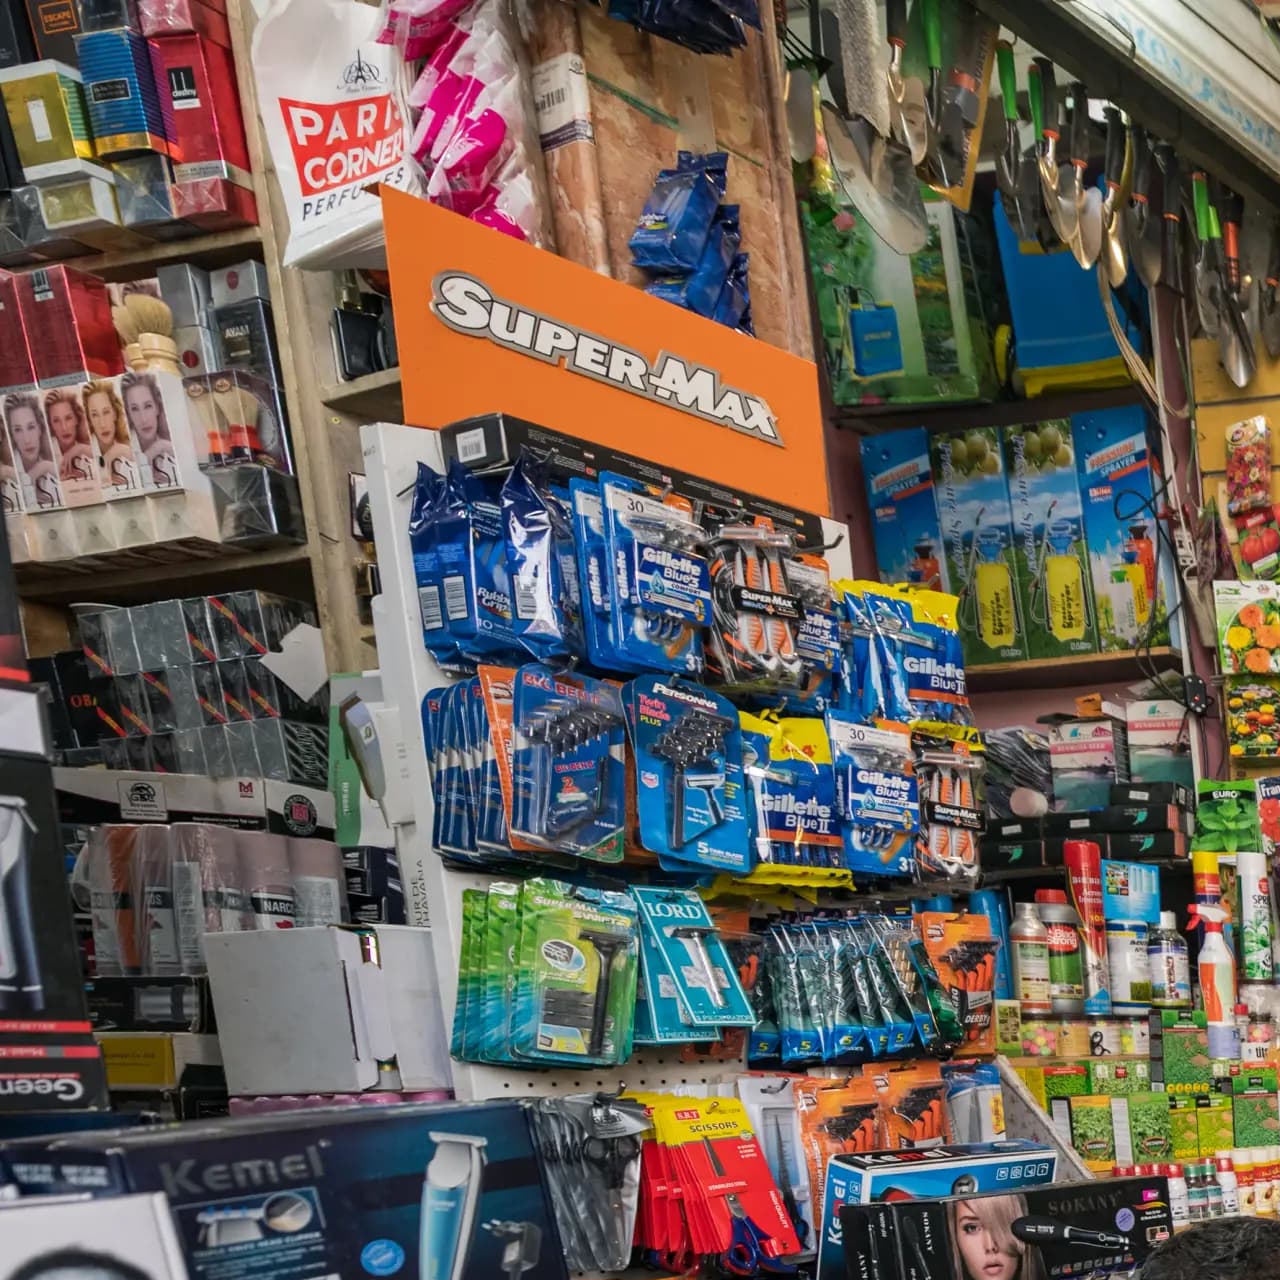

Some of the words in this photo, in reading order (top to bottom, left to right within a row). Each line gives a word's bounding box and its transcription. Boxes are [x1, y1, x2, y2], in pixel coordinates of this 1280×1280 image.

[289, 99, 403, 147] PARI
[304, 135, 402, 190] CORNER
[301, 166, 404, 222] PERFUES
[433, 273, 778, 441] SUPER-MAX
[1100, 455, 1137, 478] SPRAYER
[884, 476, 921, 496] SPRAYER
[627, 499, 644, 513] 30
[642, 547, 702, 576] Gillette
[588, 556, 602, 605] Gillette
[615, 549, 630, 599] Gillette
[903, 657, 965, 678] Gillette
[652, 682, 718, 711] PERSONNA
[640, 705, 671, 722] Blade
[640, 715, 662, 728] PLUS
[850, 728, 865, 740] 30
[857, 770, 911, 791] Gillette
[875, 785, 909, 801] Blue3
[1212, 790, 1240, 800] EURO
[761, 793, 831, 818] Gillette
[697, 842, 709, 855] 5
[649, 901, 703, 920] LORD
[689, 1121, 739, 1133] SCISSORS
[1048, 1191, 1119, 1216] SOKANY
[775, 1204, 790, 1229] QUALITY
[922, 1211, 936, 1252] SOKANY
